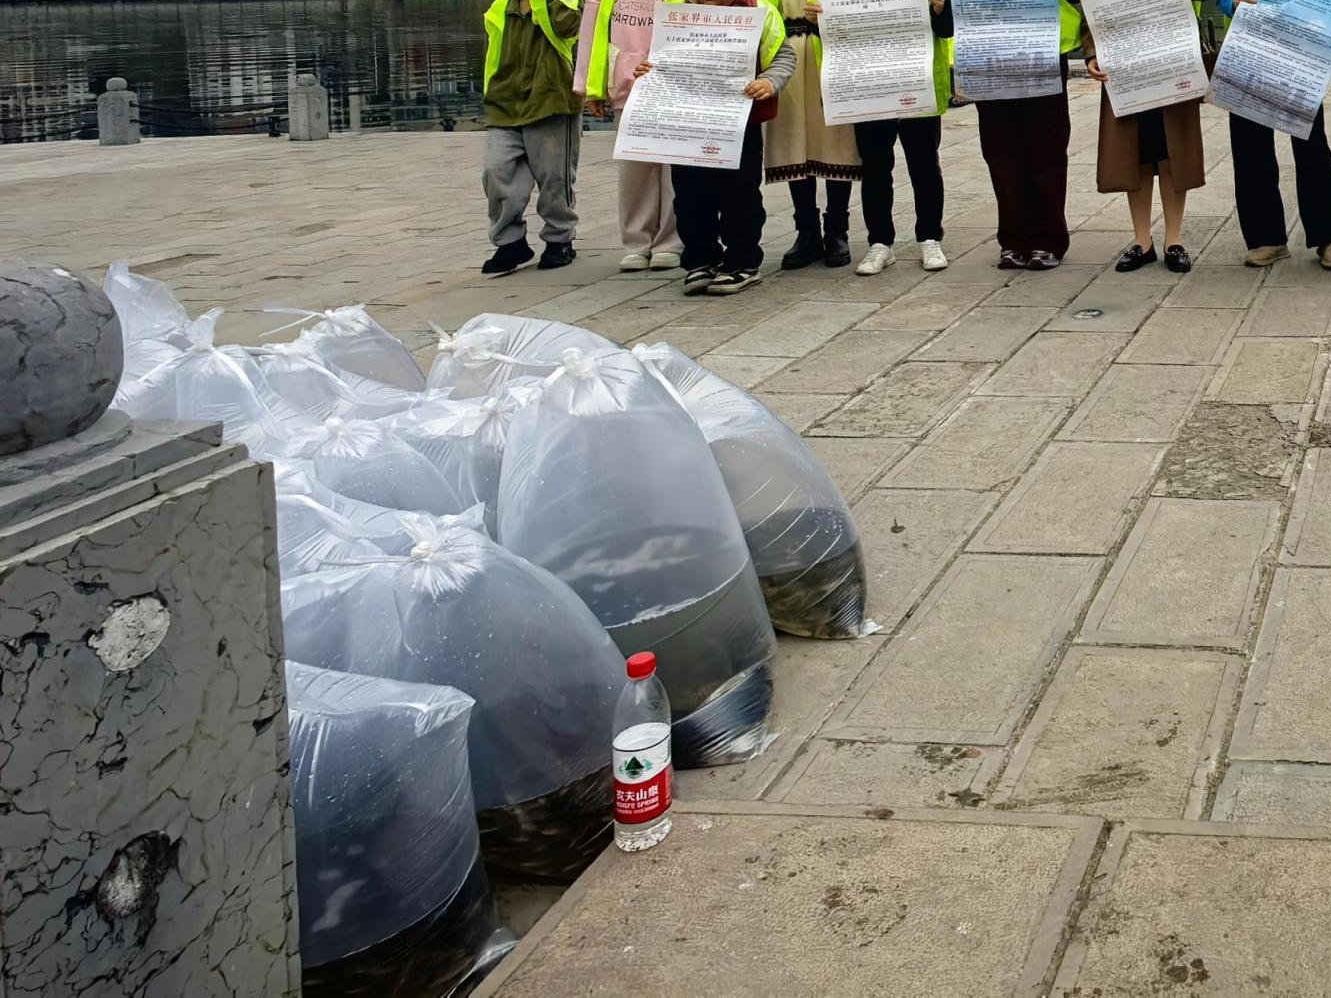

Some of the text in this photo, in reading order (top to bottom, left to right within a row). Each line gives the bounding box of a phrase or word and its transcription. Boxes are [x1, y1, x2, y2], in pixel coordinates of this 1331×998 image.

[612, 11, 654, 26] ARDWA
[668, 10, 753, 25] 张家界市人民政府
[616, 784, 658, 802] 农夫山泉
